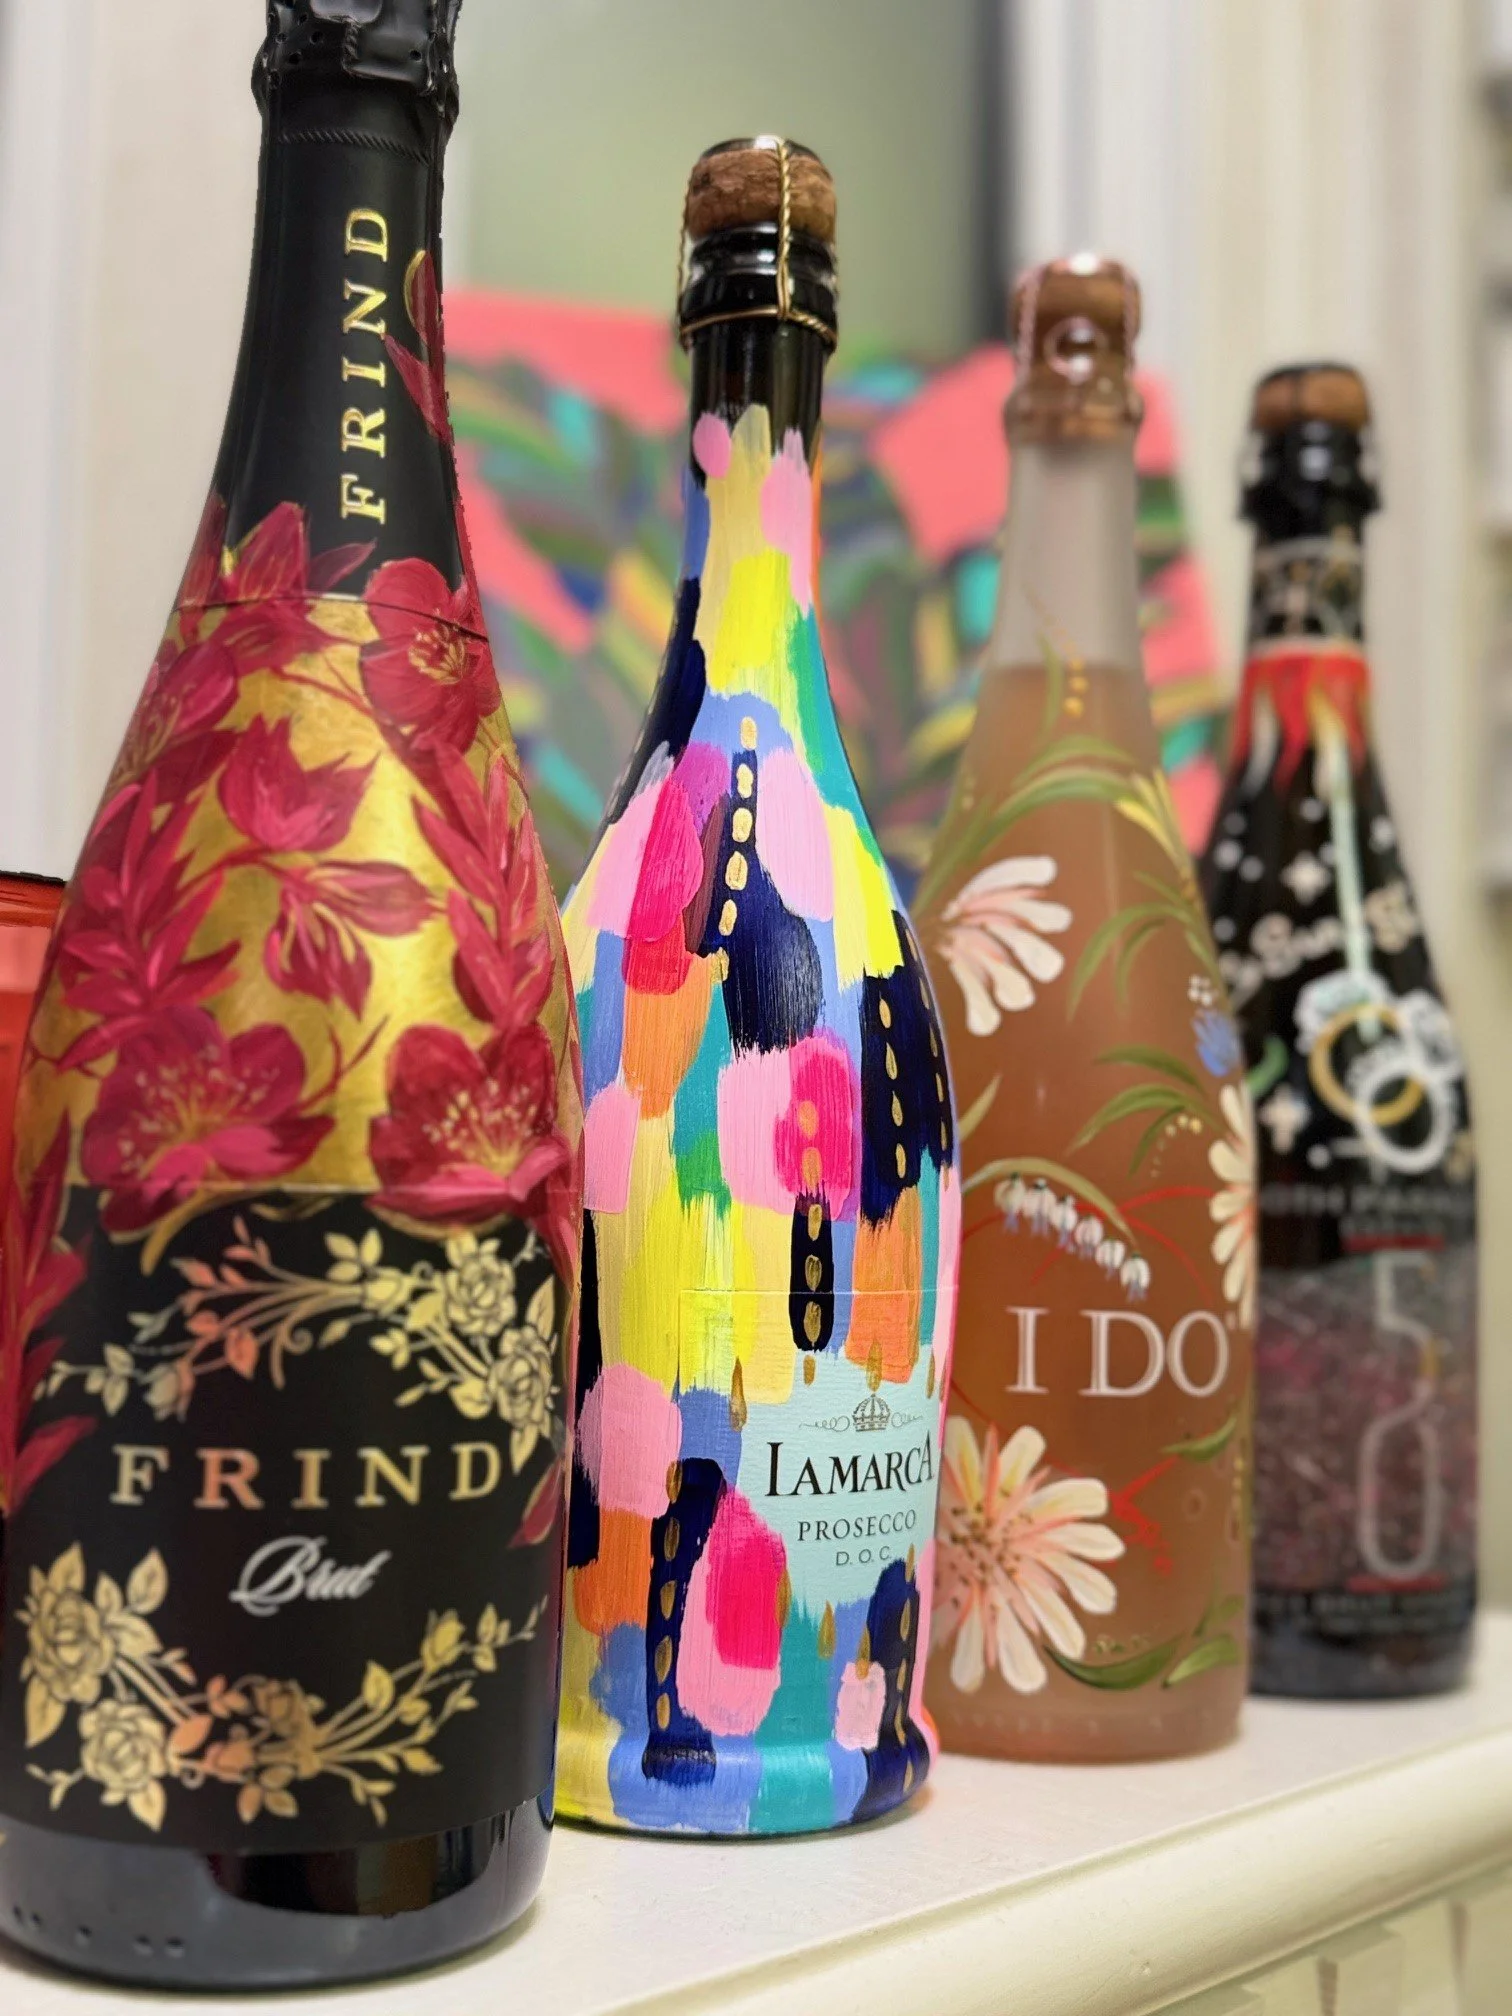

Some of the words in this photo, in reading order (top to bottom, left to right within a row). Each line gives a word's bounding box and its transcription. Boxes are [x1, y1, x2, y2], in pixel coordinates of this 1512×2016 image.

[341, 207, 390, 525] FRIND
[1005, 1305, 1050, 1394] I
[1078, 1309, 1230, 1397] DO
[109, 1441, 504, 1510] FRIND
[797, 1508, 917, 1542] PROSECCO
[229, 1535, 393, 1617] Brut
